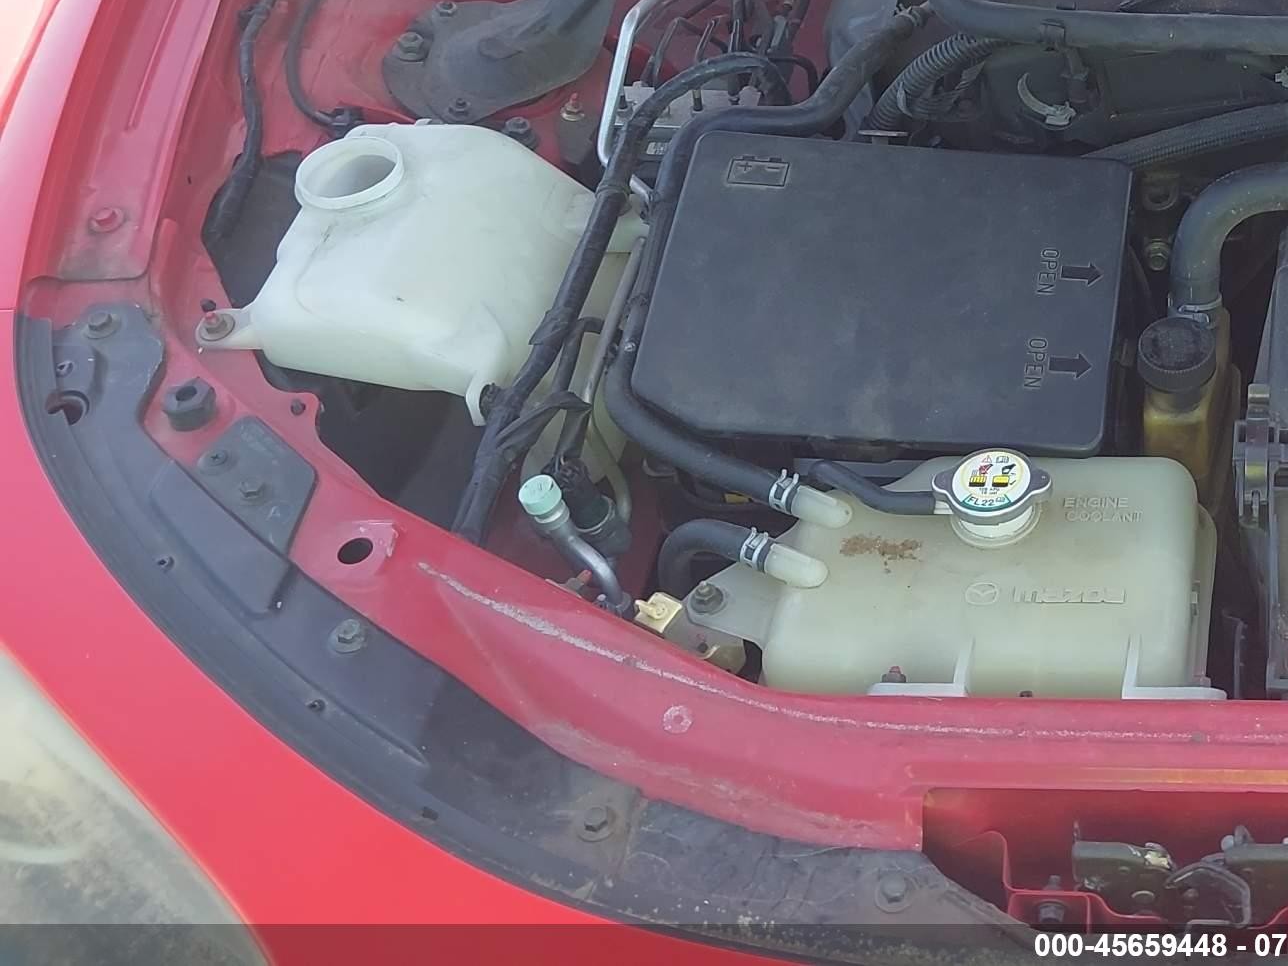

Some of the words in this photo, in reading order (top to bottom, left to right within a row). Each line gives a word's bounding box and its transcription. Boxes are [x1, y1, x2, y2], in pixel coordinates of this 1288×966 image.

[1037, 248, 1060, 295] OPEN
[1023, 338, 1048, 389] OPEN
[967, 496, 995, 506] FL22
[1063, 497, 1129, 508] ENGINE
[1065, 510, 1143, 522] COOLANT
